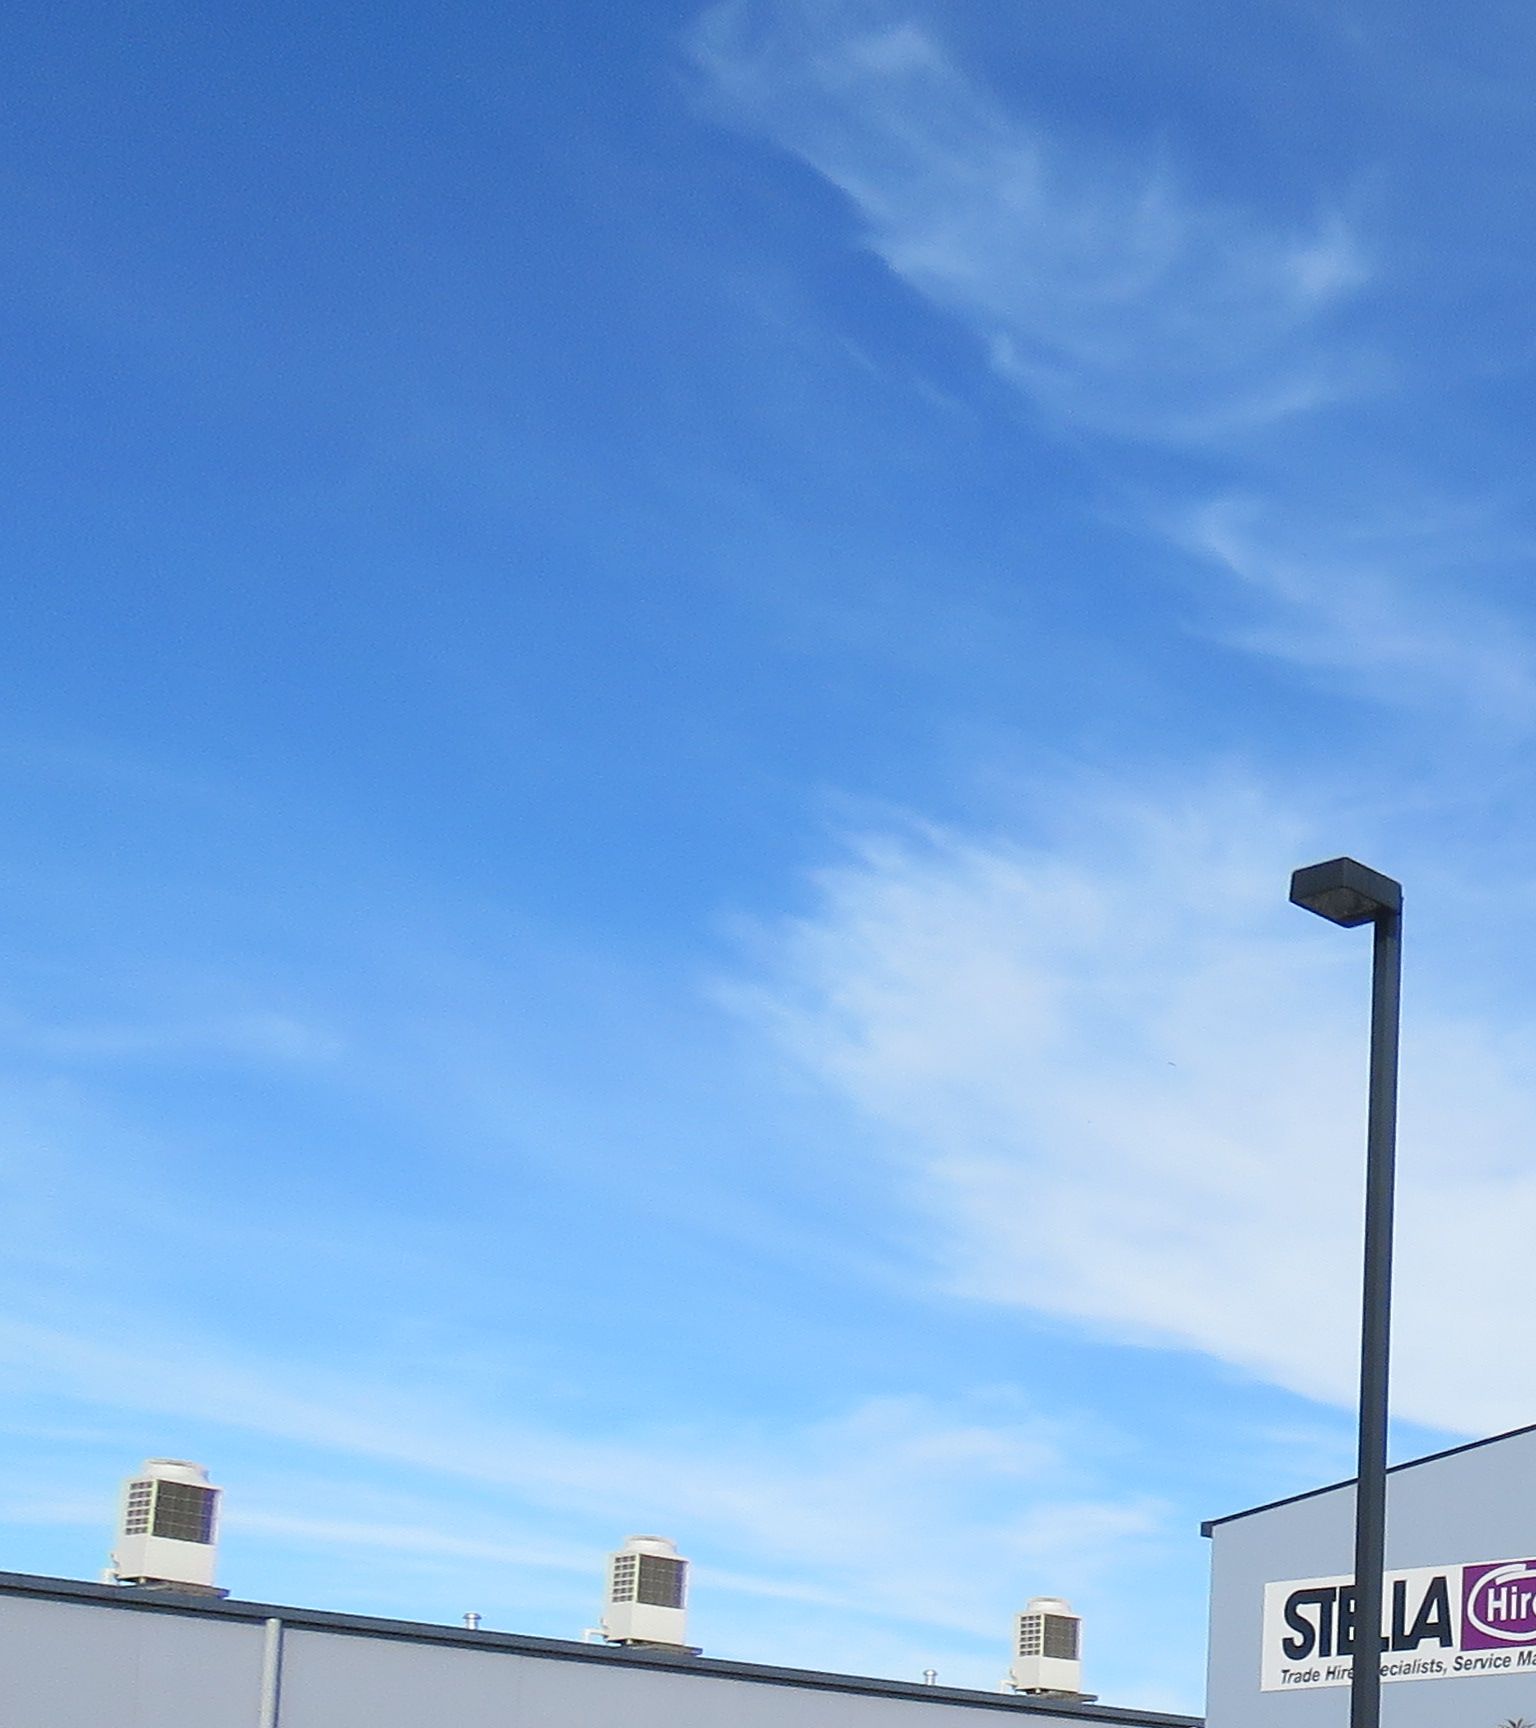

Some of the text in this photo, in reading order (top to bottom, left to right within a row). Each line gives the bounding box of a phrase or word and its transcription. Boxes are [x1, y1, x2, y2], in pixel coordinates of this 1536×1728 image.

[1281, 1575, 1453, 1661] STELA
[1281, 1667, 1320, 1685] Trade
[1379, 1657, 1448, 1677] ecialists,
[1453, 1654, 1511, 1672] Service
